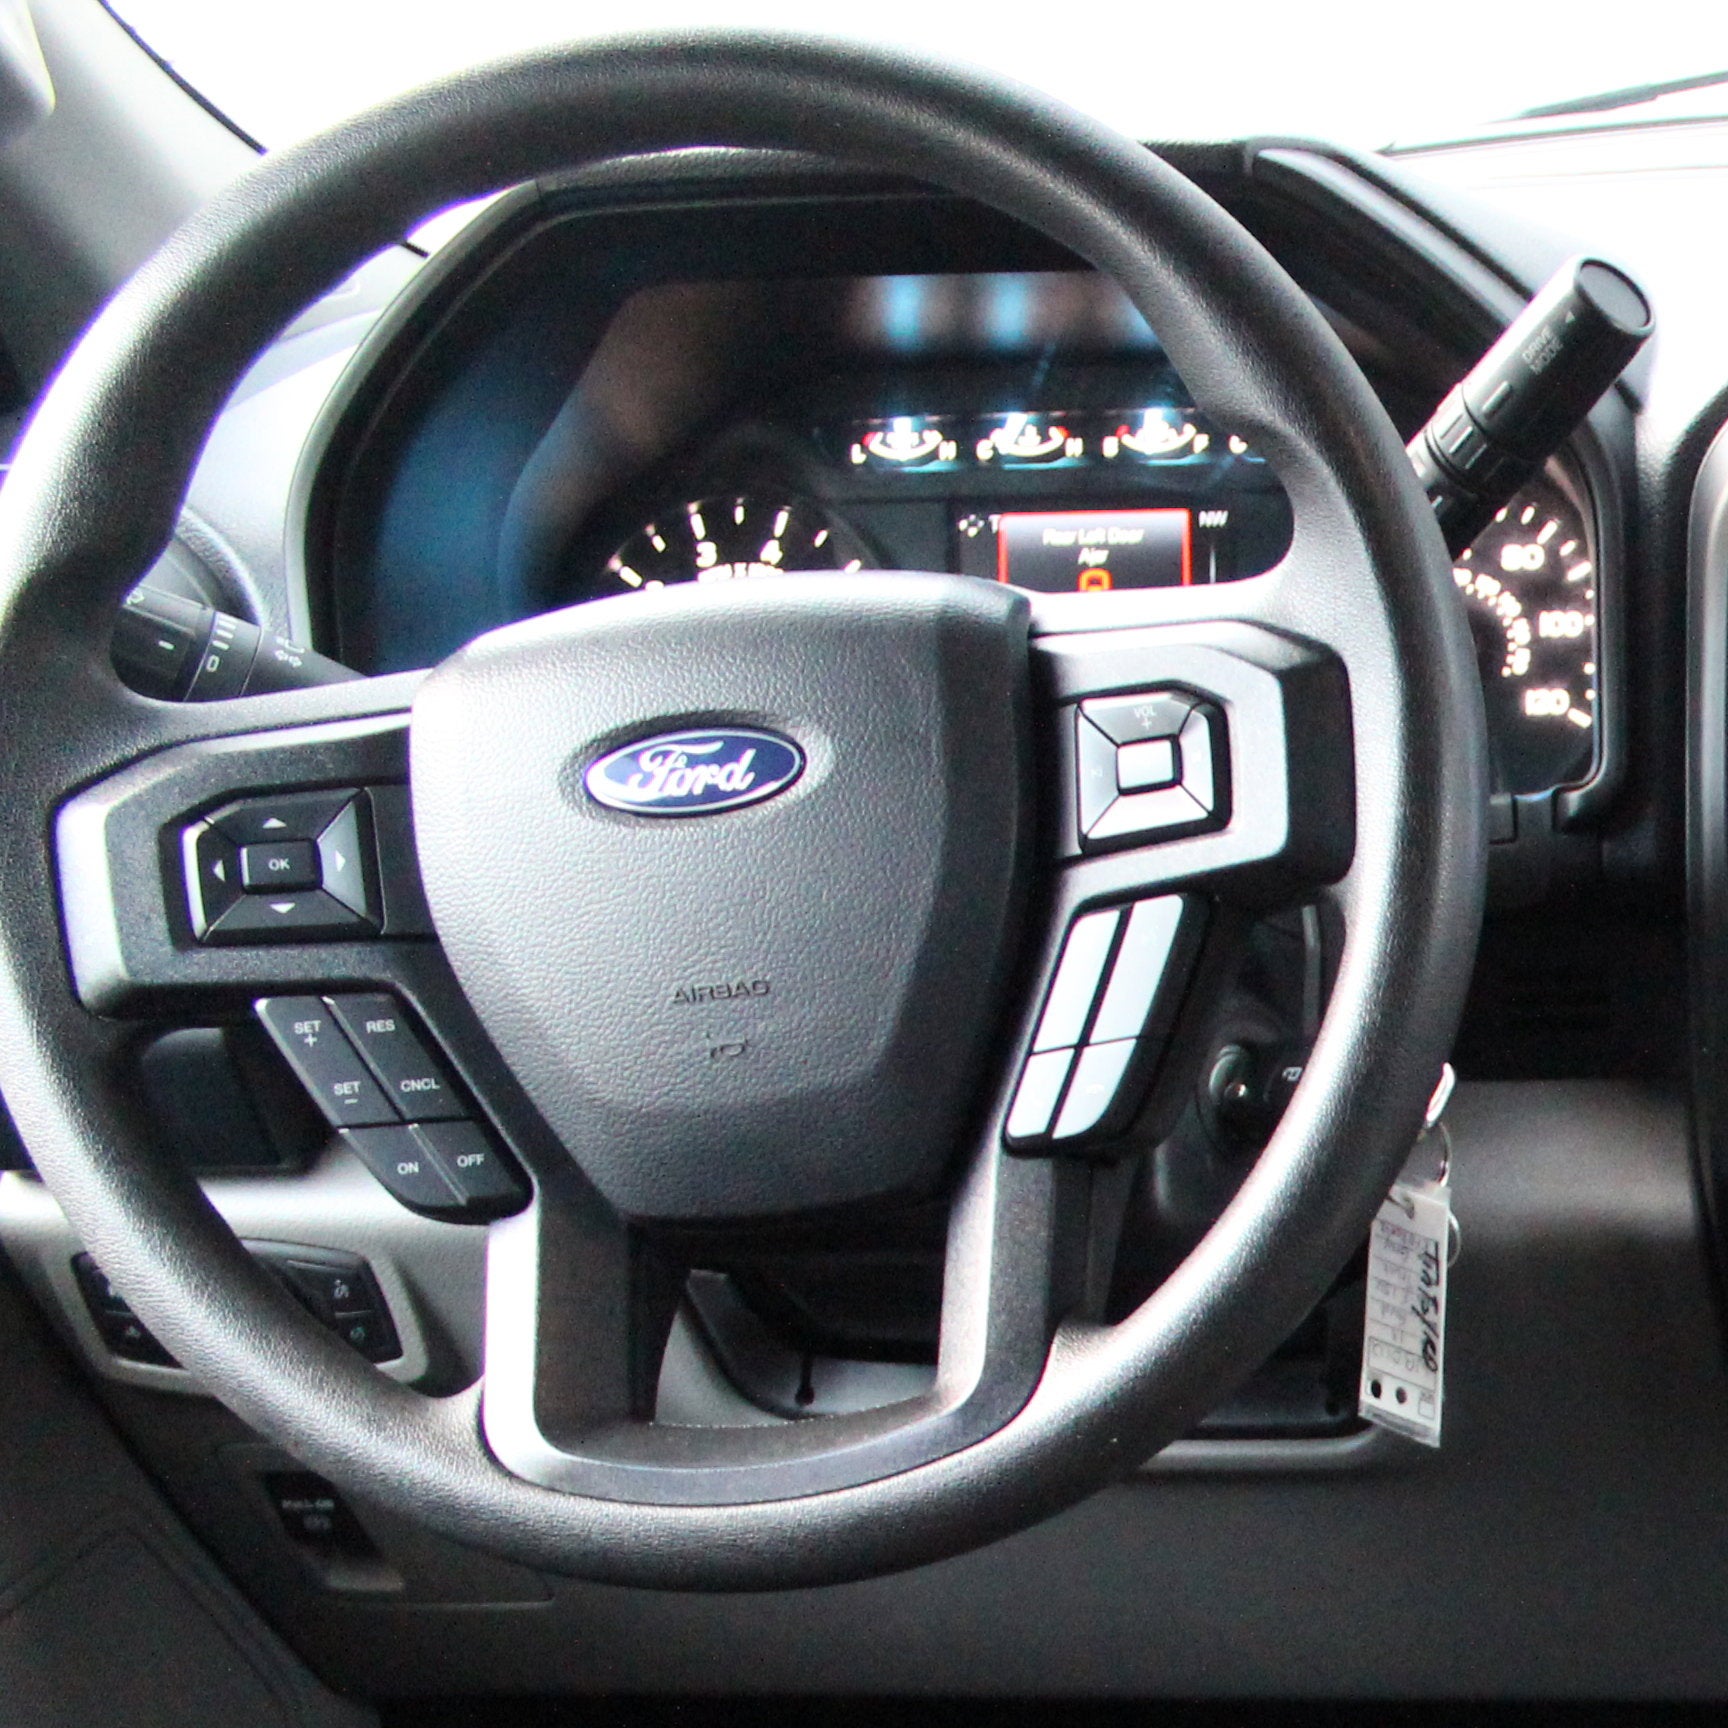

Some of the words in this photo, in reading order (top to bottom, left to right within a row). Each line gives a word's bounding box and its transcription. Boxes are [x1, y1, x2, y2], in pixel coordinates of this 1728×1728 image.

[1198, 510, 1229, 528] NW
[696, 541, 717, 568] 3
[760, 539, 783, 566] 4
[1501, 543, 1545, 572] 80
[1539, 610, 1584, 638] 100
[1525, 688, 1570, 716] 120
[1133, 705, 1157, 719] VOL
[626, 740, 756, 802] Ford
[268, 857, 291, 872] OK
[673, 980, 770, 1004] AIRBAG
[294, 1020, 321, 1034] SET
[366, 1020, 396, 1033] RES
[334, 1081, 361, 1096] SET
[401, 1078, 441, 1092] CNCL
[397, 1162, 419, 1175] ON
[456, 1153, 485, 1168] OFF
